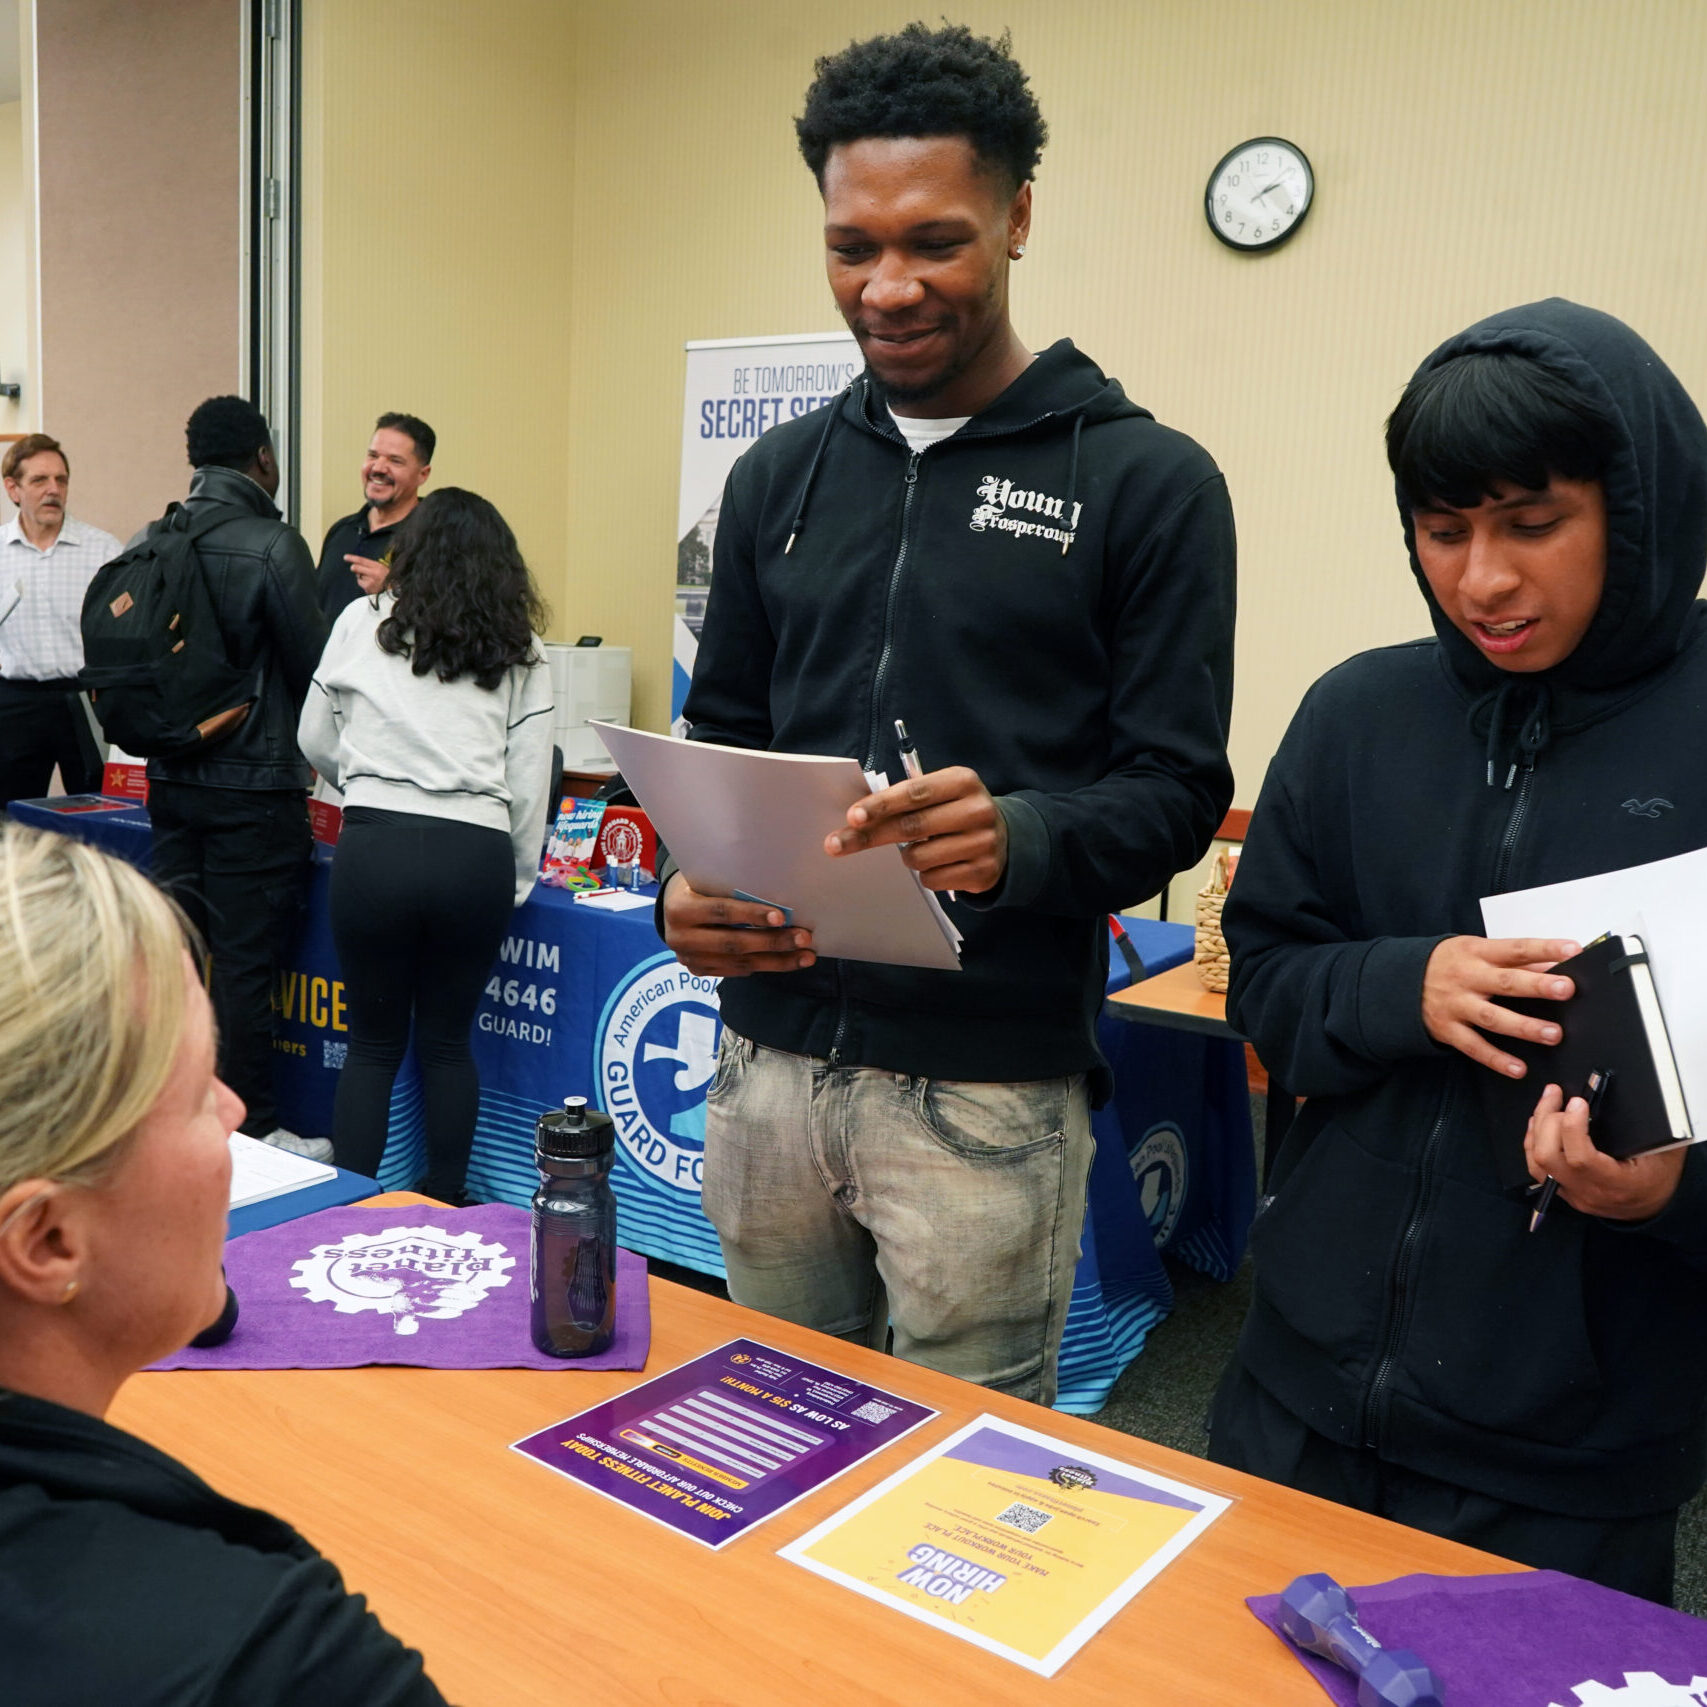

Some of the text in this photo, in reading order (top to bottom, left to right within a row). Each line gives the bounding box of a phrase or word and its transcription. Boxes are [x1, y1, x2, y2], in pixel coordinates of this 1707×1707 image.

[1240, 160, 1250, 173] 11
[1228, 174, 1240, 187] 10
[1219, 194, 1228, 206] 9
[1225, 211, 1232, 223] 8
[1286, 204, 1294, 215] 4
[1239, 222, 1246, 235] 7
[1253, 227, 1262, 238] 6
[1272, 219, 1280, 231] 5
[733, 363, 855, 394] BE TOMORROW'S
[700, 398, 784, 439] SECRET
[278, 971, 349, 1032] VICE
[485, 975, 557, 1016] 4646
[613, 977, 675, 1048] American
[607, 1061, 667, 1166] GUARD
[324, 1244, 476, 1262] fitness
[349, 1257, 494, 1276] planet
[720, 1376, 764, 1396] MONTH!
[769, 1396, 792, 1408] $15
[789, 1404, 808, 1414] AS
[804, 1410, 834, 1425] LOW
[830, 1420, 850, 1430] AS
[576, 1433, 631, 1460] MEMBERSHIPS
[627, 1457, 680, 1483] AFFORDABLE
[561, 1439, 731, 1520] JOIN PLANET FITNESS TODAY
[677, 1480, 698, 1492] OUR
[694, 1489, 715, 1500] OUT
[712, 1497, 744, 1513] CHECK
[924, 1523, 1049, 1577] MAKE YOUR WORKOUT PLACE
[1007, 1547, 1033, 1561] YOUR
[911, 1547, 1004, 1592] HIRING
[901, 1568, 972, 1604] NOW
